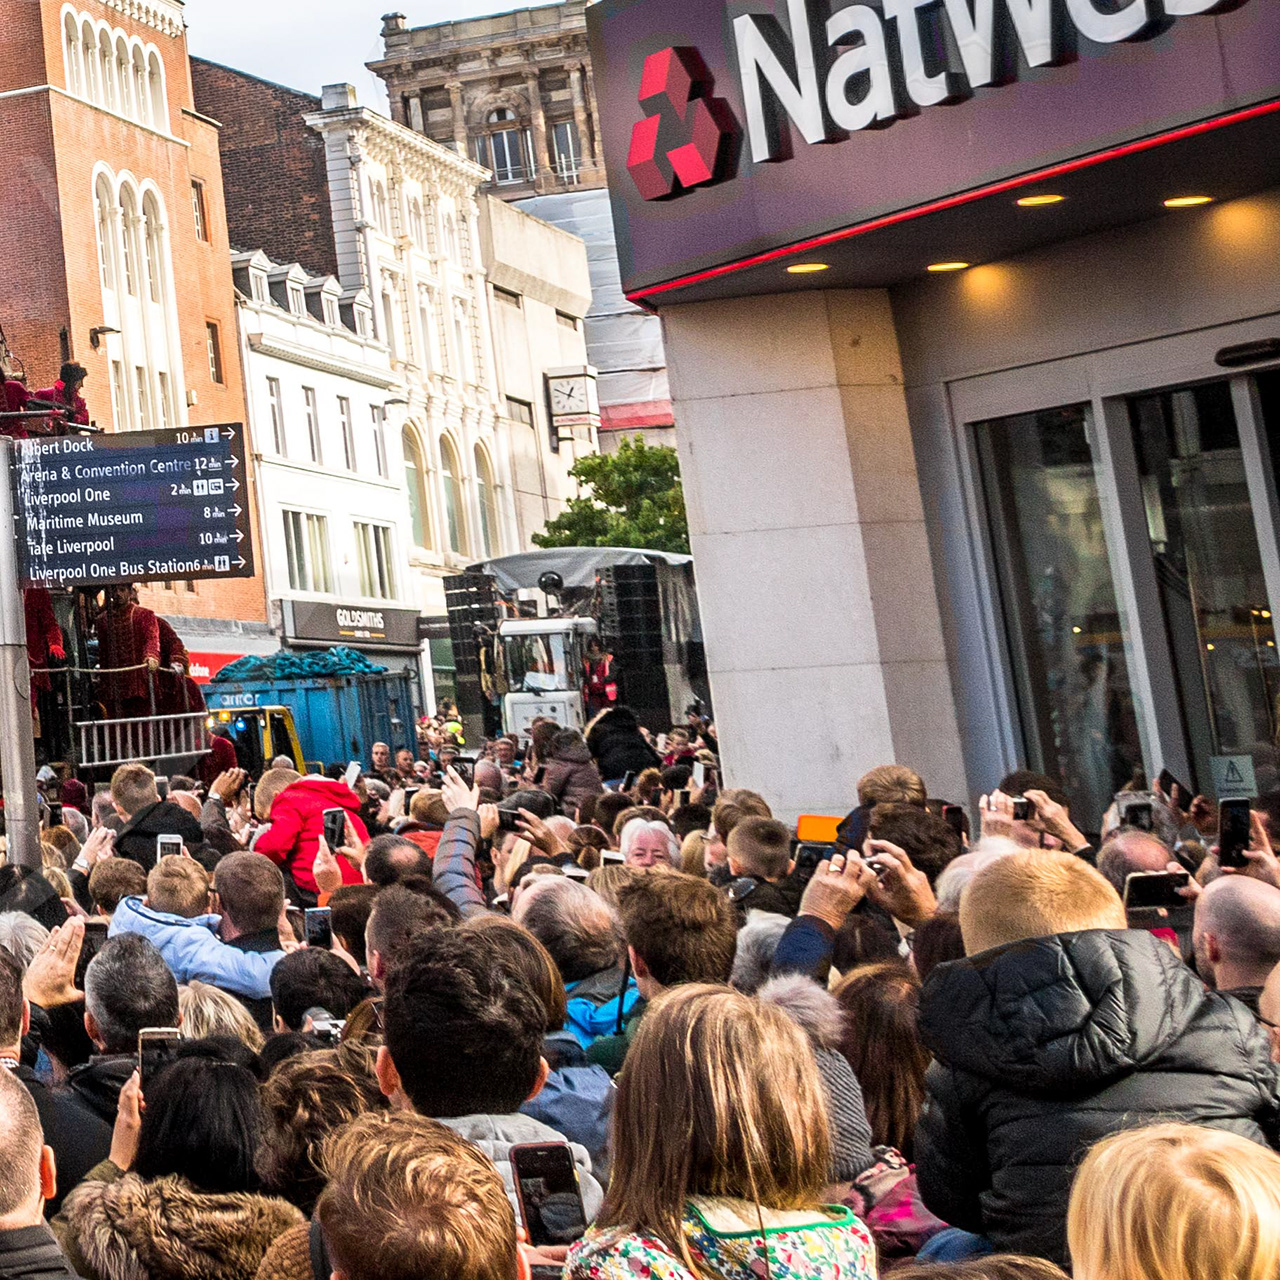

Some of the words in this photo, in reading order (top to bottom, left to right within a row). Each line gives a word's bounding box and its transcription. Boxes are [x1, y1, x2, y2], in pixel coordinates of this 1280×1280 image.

[63, 438, 94, 453] Dock
[176, 432, 189, 444] 10
[21, 469, 57, 483] Arena
[61, 466, 71, 479] &
[75, 461, 146, 479] Convention
[150, 459, 191, 473] Centre
[194, 458, 207, 470] 12
[25, 488, 81, 507] Liverpool
[85, 488, 111, 502] One
[170, 484, 178, 495] 2
[27, 514, 84, 531] Maritime
[88, 511, 143, 527] Museum
[203, 507, 211, 518] 8
[57, 536, 114, 556] Liverpool
[199, 533, 213, 545] 10
[29, 564, 87, 582] Liverpool
[91, 563, 116, 577] One
[120, 561, 144, 576] Bus
[147, 558, 193, 575] Station
[336, 608, 385, 629] GOLDSMITHS
